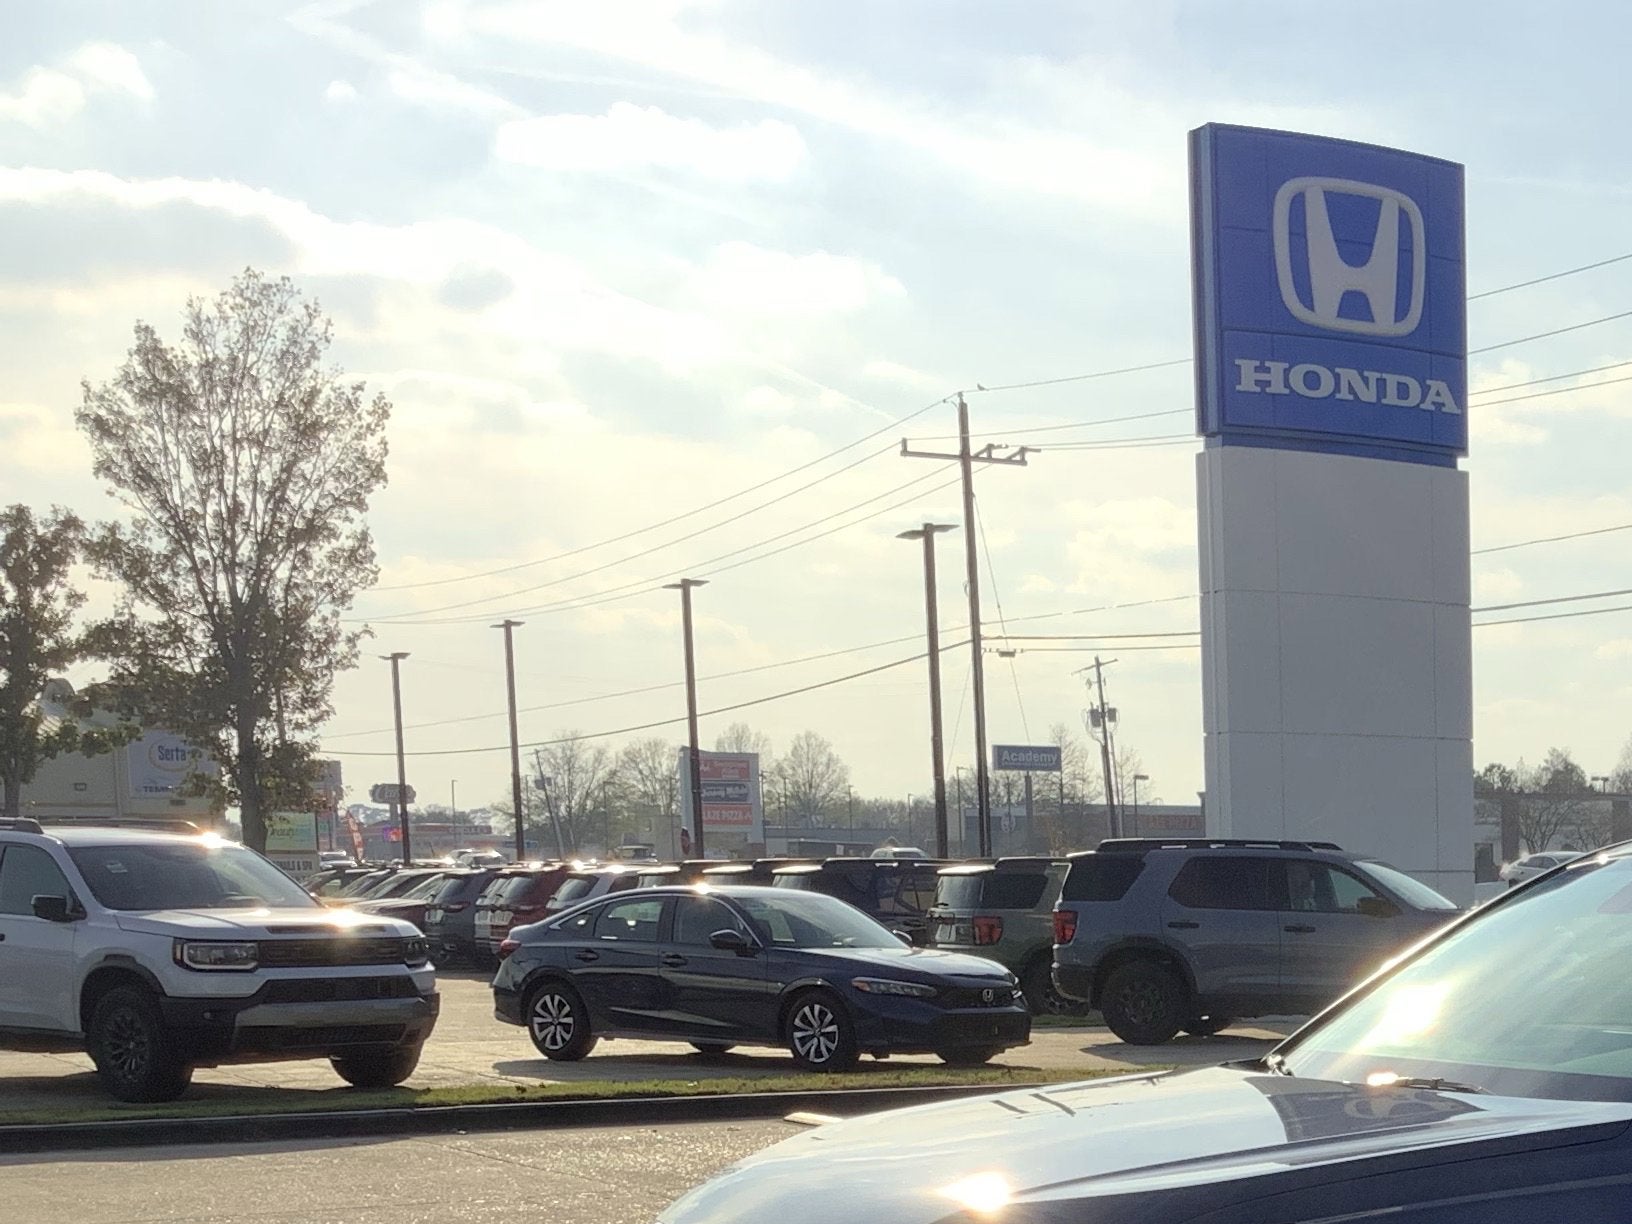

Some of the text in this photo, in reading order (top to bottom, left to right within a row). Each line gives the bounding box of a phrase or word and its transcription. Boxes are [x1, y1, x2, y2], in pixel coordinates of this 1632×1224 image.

[1234, 358, 1462, 415] HONDA
[158, 745, 187, 761] Serta
[1002, 750, 1057, 765] Academy
